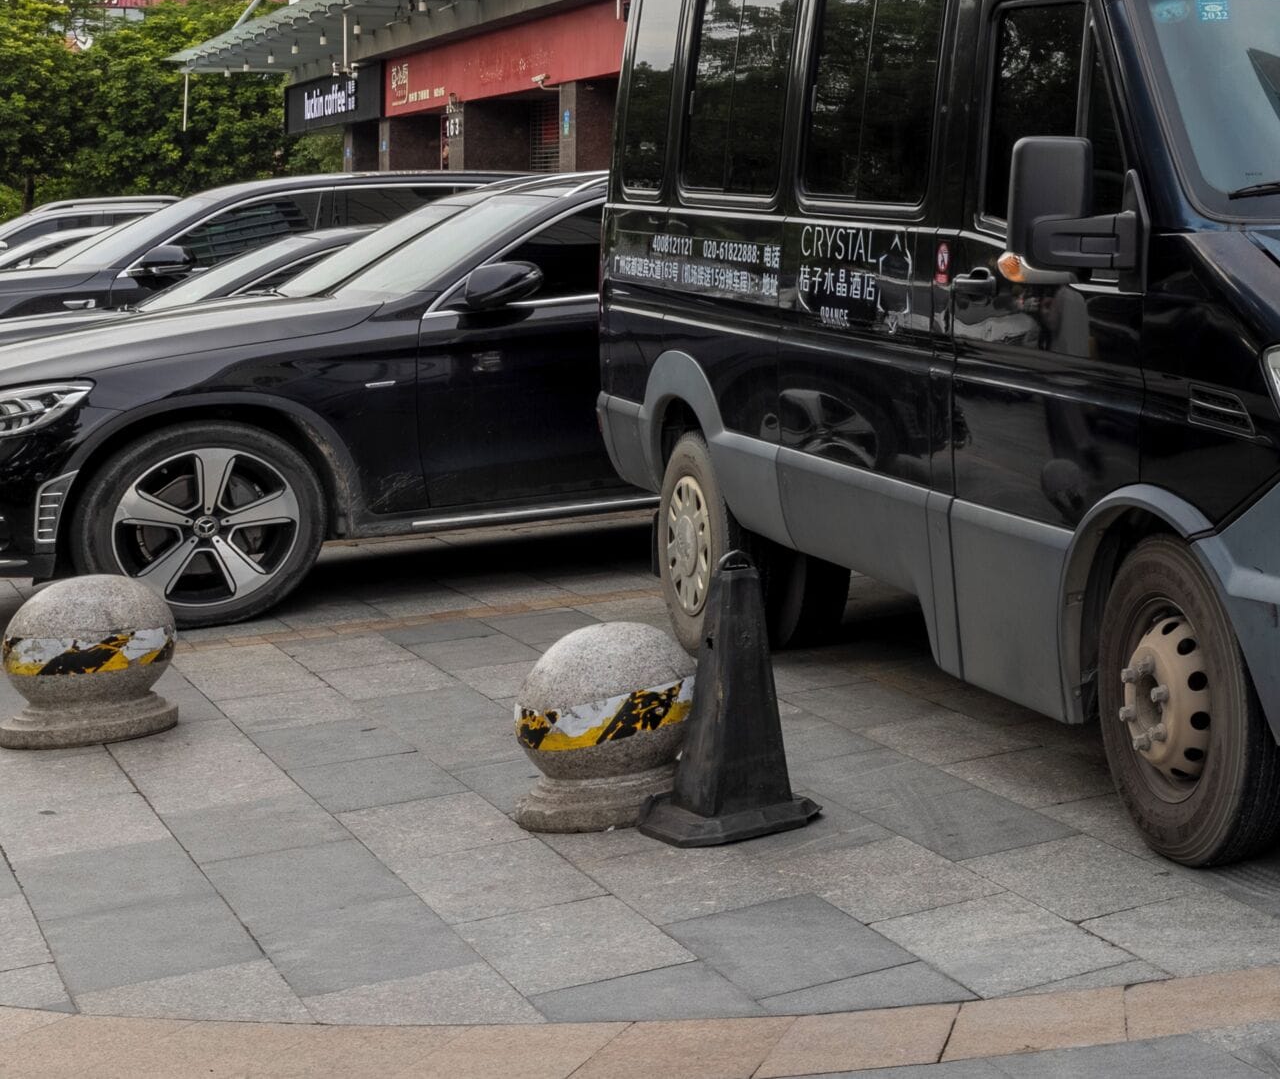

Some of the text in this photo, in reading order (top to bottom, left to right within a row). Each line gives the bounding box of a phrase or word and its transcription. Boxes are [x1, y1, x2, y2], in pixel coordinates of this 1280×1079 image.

[1202, 10, 1229, 20] 2022
[324, 83, 346, 116] coffee
[652, 234, 693, 256] 4008121121
[801, 225, 877, 264] CRYSTAL
[800, 265, 876, 301] 桔子水晶酒店
[820, 306, 849, 327] ORANGE
